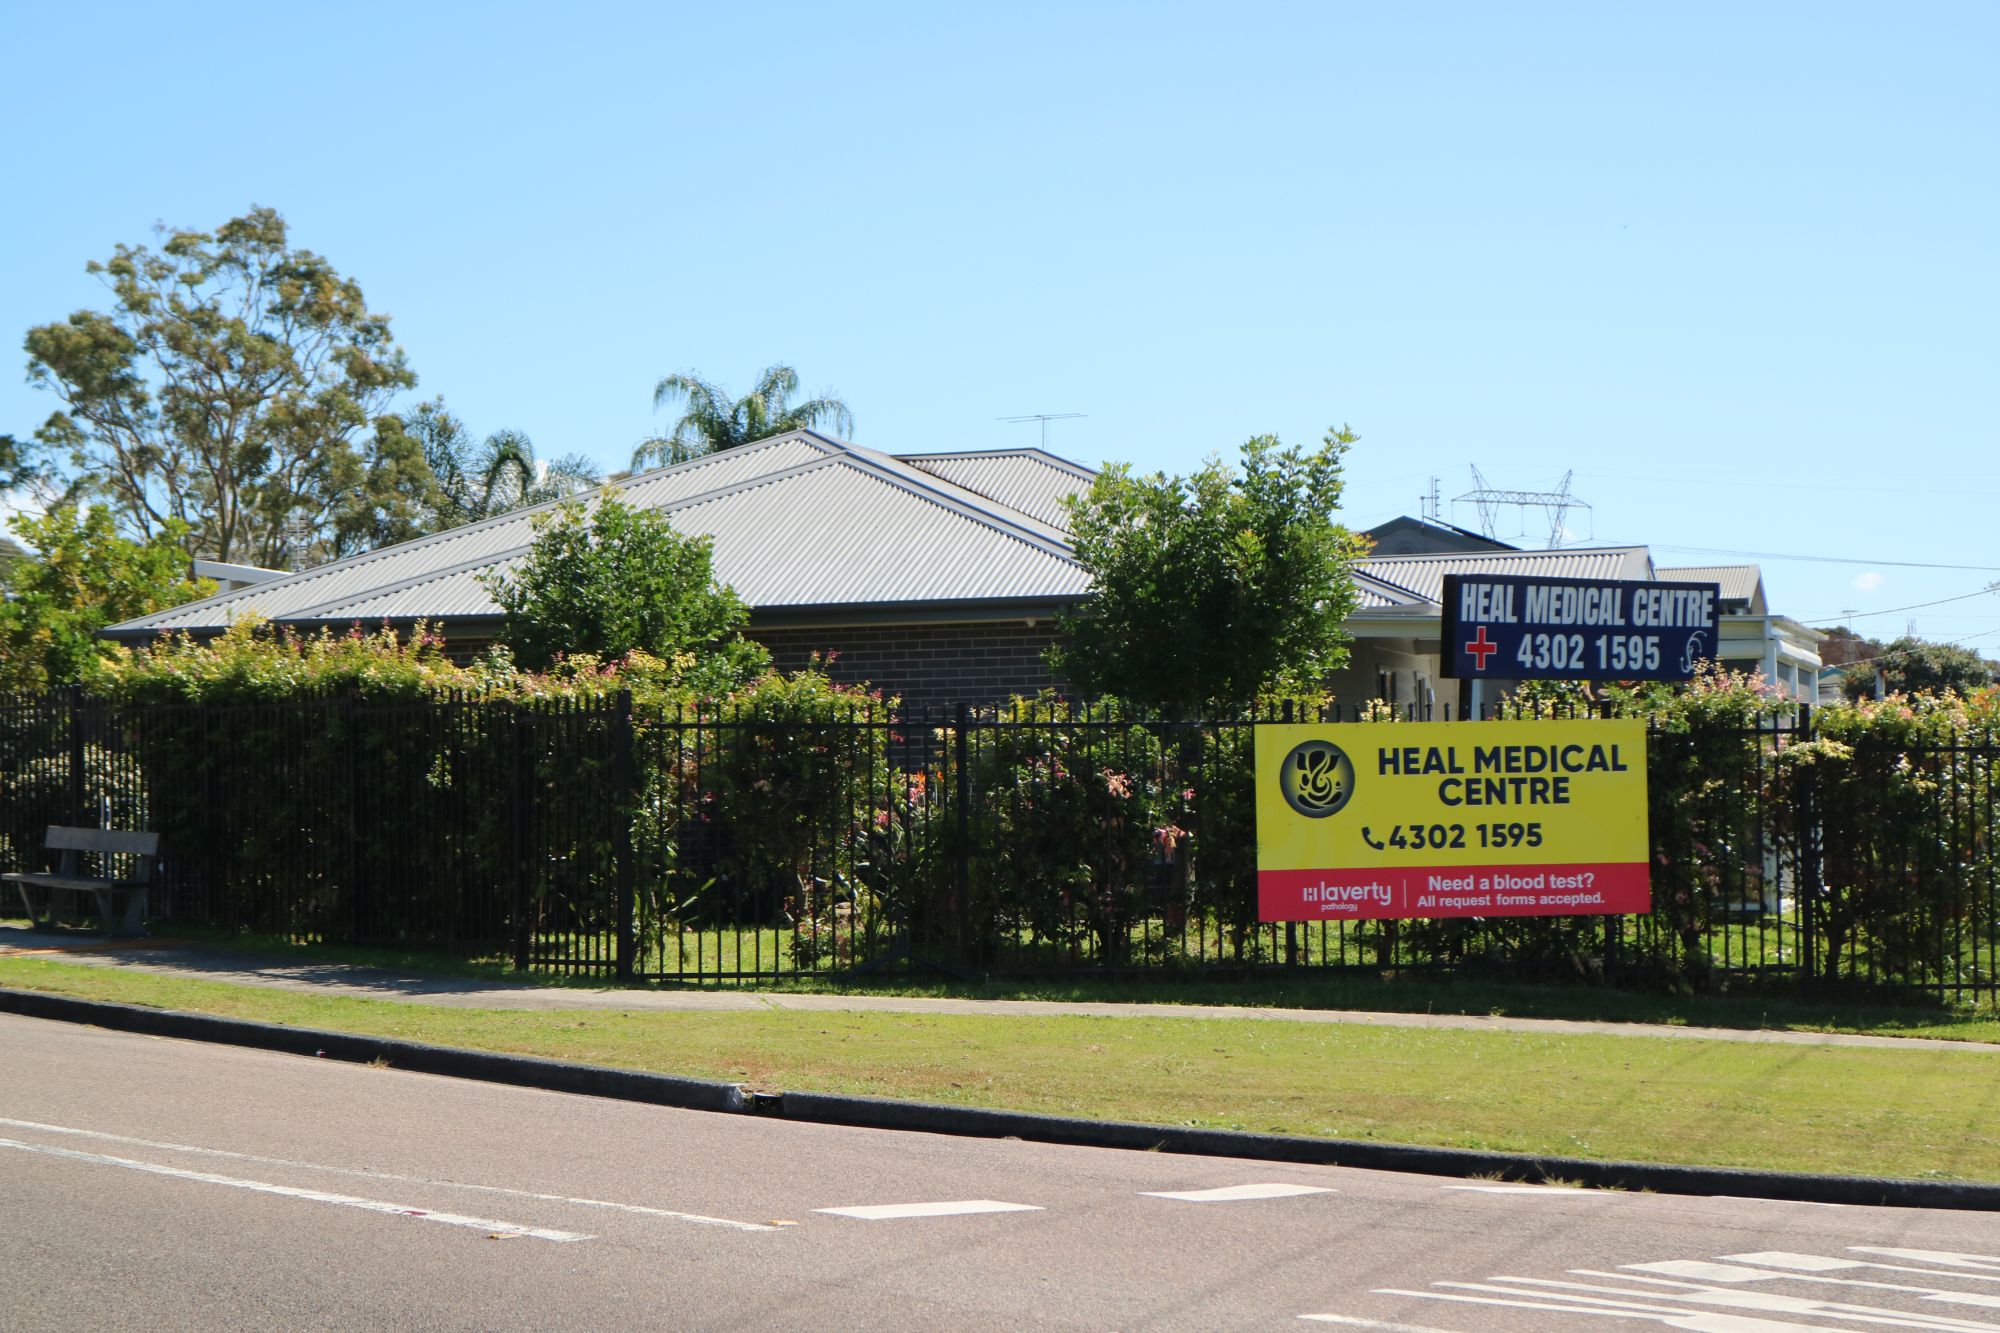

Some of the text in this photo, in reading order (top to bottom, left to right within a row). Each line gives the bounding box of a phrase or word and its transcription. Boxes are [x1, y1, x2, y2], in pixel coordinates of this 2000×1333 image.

[1461, 583, 1714, 628] HEAL MEDICAL CENTRE
[1517, 633, 1660, 671] 4302 1595
[1378, 744, 1628, 775] HEAL MEDICAL
[1438, 776, 1570, 806] CENTRE
[1389, 822, 1543, 849] 4302 1595
[1320, 880, 1392, 906] laverty
[1428, 872, 1595, 891] Need a blood test?
[1321, 901, 1358, 912] pathology
[1417, 891, 1605, 908] All request forms accepted.
